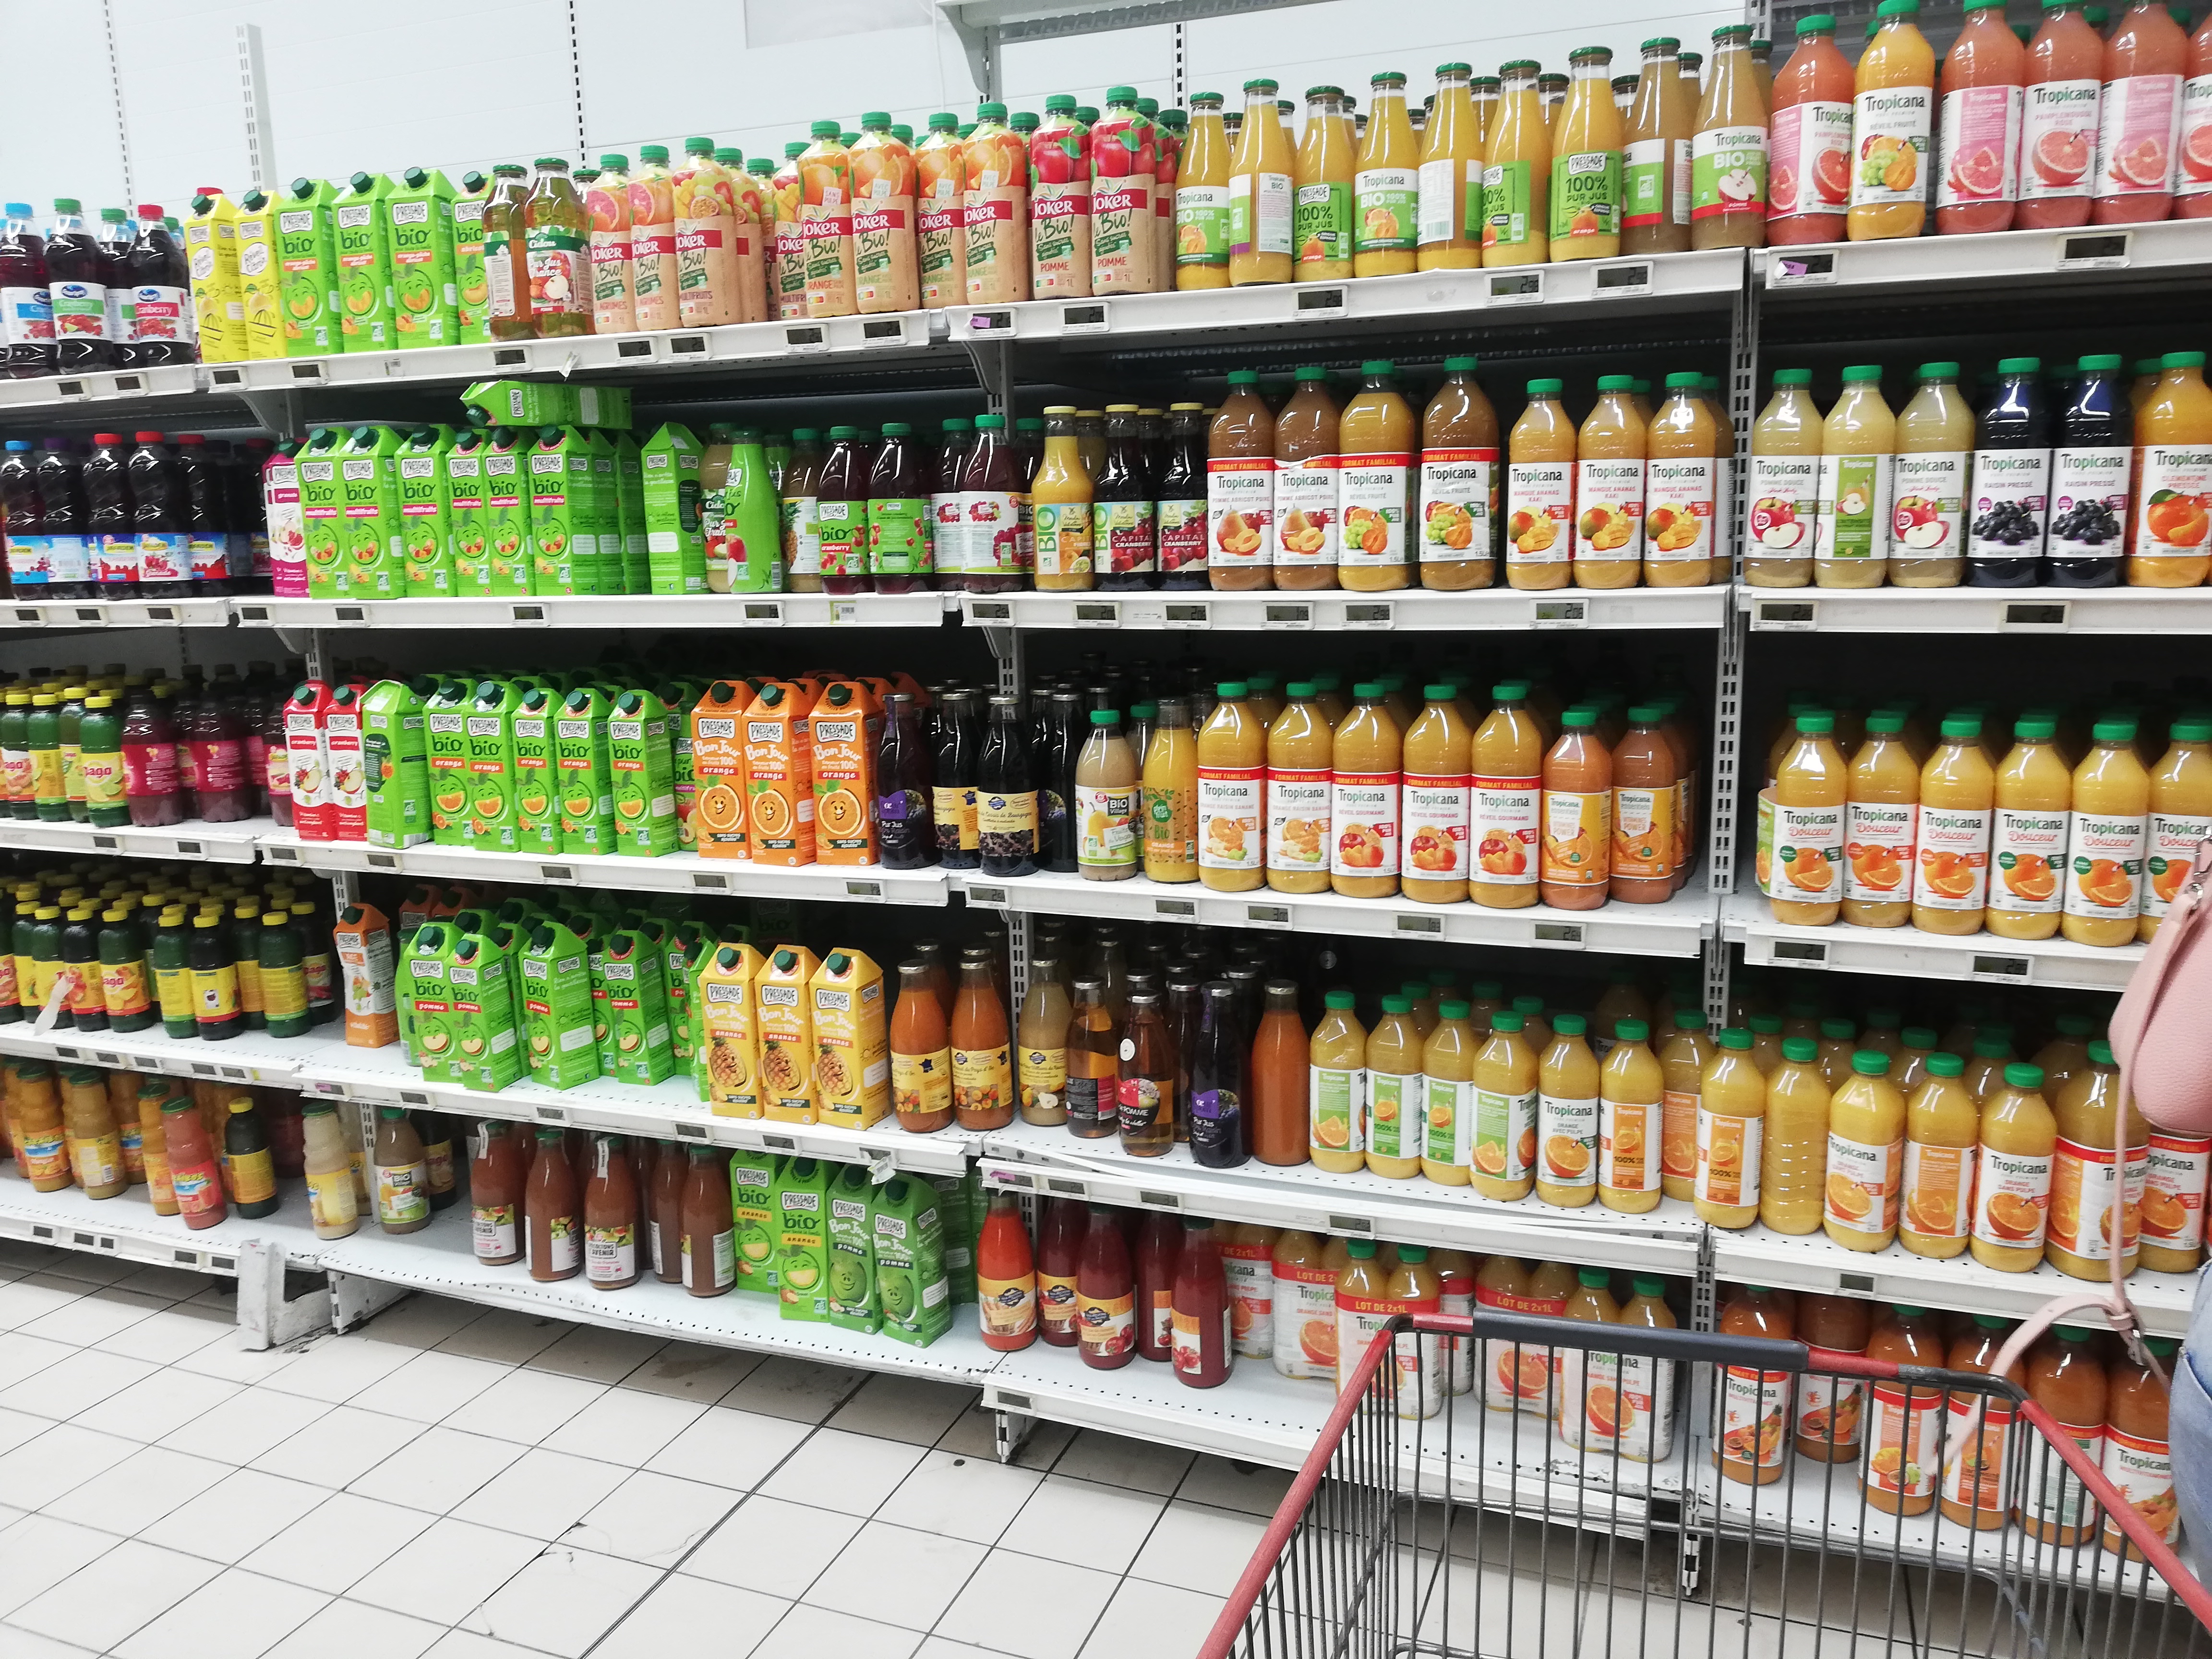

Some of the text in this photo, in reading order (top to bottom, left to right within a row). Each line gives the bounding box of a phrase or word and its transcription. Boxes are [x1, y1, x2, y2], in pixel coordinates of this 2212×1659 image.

[2034, 86, 2096, 105] Tropicana
[1865, 95, 1926, 112] Tropicana
[1715, 133, 1761, 146] Tropicana
[1714, 152, 1745, 168] BIO
[1363, 175, 1405, 188] Tropicana
[1565, 176, 1608, 193] 100%
[1360, 193, 1385, 208] BIO
[1566, 192, 1607, 203] PUR JUS
[1298, 206, 1333, 222] 100%
[340, 231, 373, 250] bio
[395, 228, 432, 246] bio
[282, 236, 315, 254] bio
[1040, 262, 1070, 272] POMME
[1098, 257, 1128, 267] POMME
[1424, 453, 1480, 462] FORMAT FAMILIAL
[1981, 455, 2042, 471] Tropicana
[2061, 454, 2124, 470] Tropicana
[1427, 467, 1477, 481] Tropicana
[1587, 464, 1639, 479] Tropicana
[1652, 464, 1706, 479] Tropicana
[1756, 460, 1811, 476] Tropicana
[1898, 458, 1954, 475] Tropicana
[1217, 476, 1264, 489] Tropicana
[1281, 474, 1329, 487] Tropicana
[1345, 472, 1394, 486] Tropicana
[1513, 469, 1563, 483] Tropicana
[305, 484, 337, 502] bio
[344, 483, 377, 501] bio
[403, 481, 435, 499] bio
[452, 481, 481, 497] bio
[489, 480, 517, 496] bio
[533, 478, 565, 495] bio
[820, 528, 852, 541] bio
[1037, 507, 1056, 552] BIO
[701, 720, 733, 736] PRESSADE
[751, 724, 781, 739] PRESSADE
[820, 724, 854, 738] PRESSADE
[432, 735, 464, 753] bio
[470, 739, 503, 757] bio
[517, 741, 546, 757] bio
[560, 742, 590, 759] bio
[612, 744, 642, 759] bio
[1203, 783, 1248, 797] Tropicana
[1278, 785, 1325, 799] Tropicana
[1338, 789, 1385, 803] Tropicana
[1410, 791, 1459, 805] Tropicana
[1479, 793, 1530, 807] Tropicana
[1550, 797, 1582, 808] Tropicana
[1619, 794, 1652, 804] Tropicana
[1784, 811, 1839, 826] Tropicana
[1851, 805, 1909, 822] Tropicana
[1855, 821, 1903, 834] Douceur
[1925, 814, 1983, 830] Tropicana
[2003, 814, 2064, 831] Tropicana
[2079, 819, 2141, 836] Tropicana
[1154, 825, 1170, 839] Bio
[1789, 825, 1833, 837] Douceur
[1928, 828, 1977, 842] Douceur
[2008, 830, 2055, 843] Douceur
[2083, 835, 2134, 849] Douceur
[413, 979, 446, 998] bio
[452, 986, 480, 1003] bio
[526, 979, 549, 998] bio
[608, 985, 637, 999] bio
[710, 986, 740, 1001] PRESSADE
[764, 987, 795, 1001] PRESSADE
[819, 992, 848, 1007] PRESSADE
[528, 1002, 549, 1013] pomme
[1545, 1101, 1593, 1117] Tropicana
[1829, 1135, 1878, 1162] Tropicana
[1613, 1155, 1635, 1164] 100%
[1990, 1155, 2048, 1174] Tropicana
[738, 1170, 768, 1185] PRESSADE
[737, 1188, 770, 1205] bio
[784, 1194, 817, 1209] PRESSADE
[835, 1202, 864, 1218] PRESSADE
[782, 1213, 821, 1230] bio
[1297, 1271, 1326, 1282] LOT DE
[1355, 1301, 1408, 1313] LOT DE 2x1L
[1497, 1296, 1553, 1313] LOT DE 2x1L
